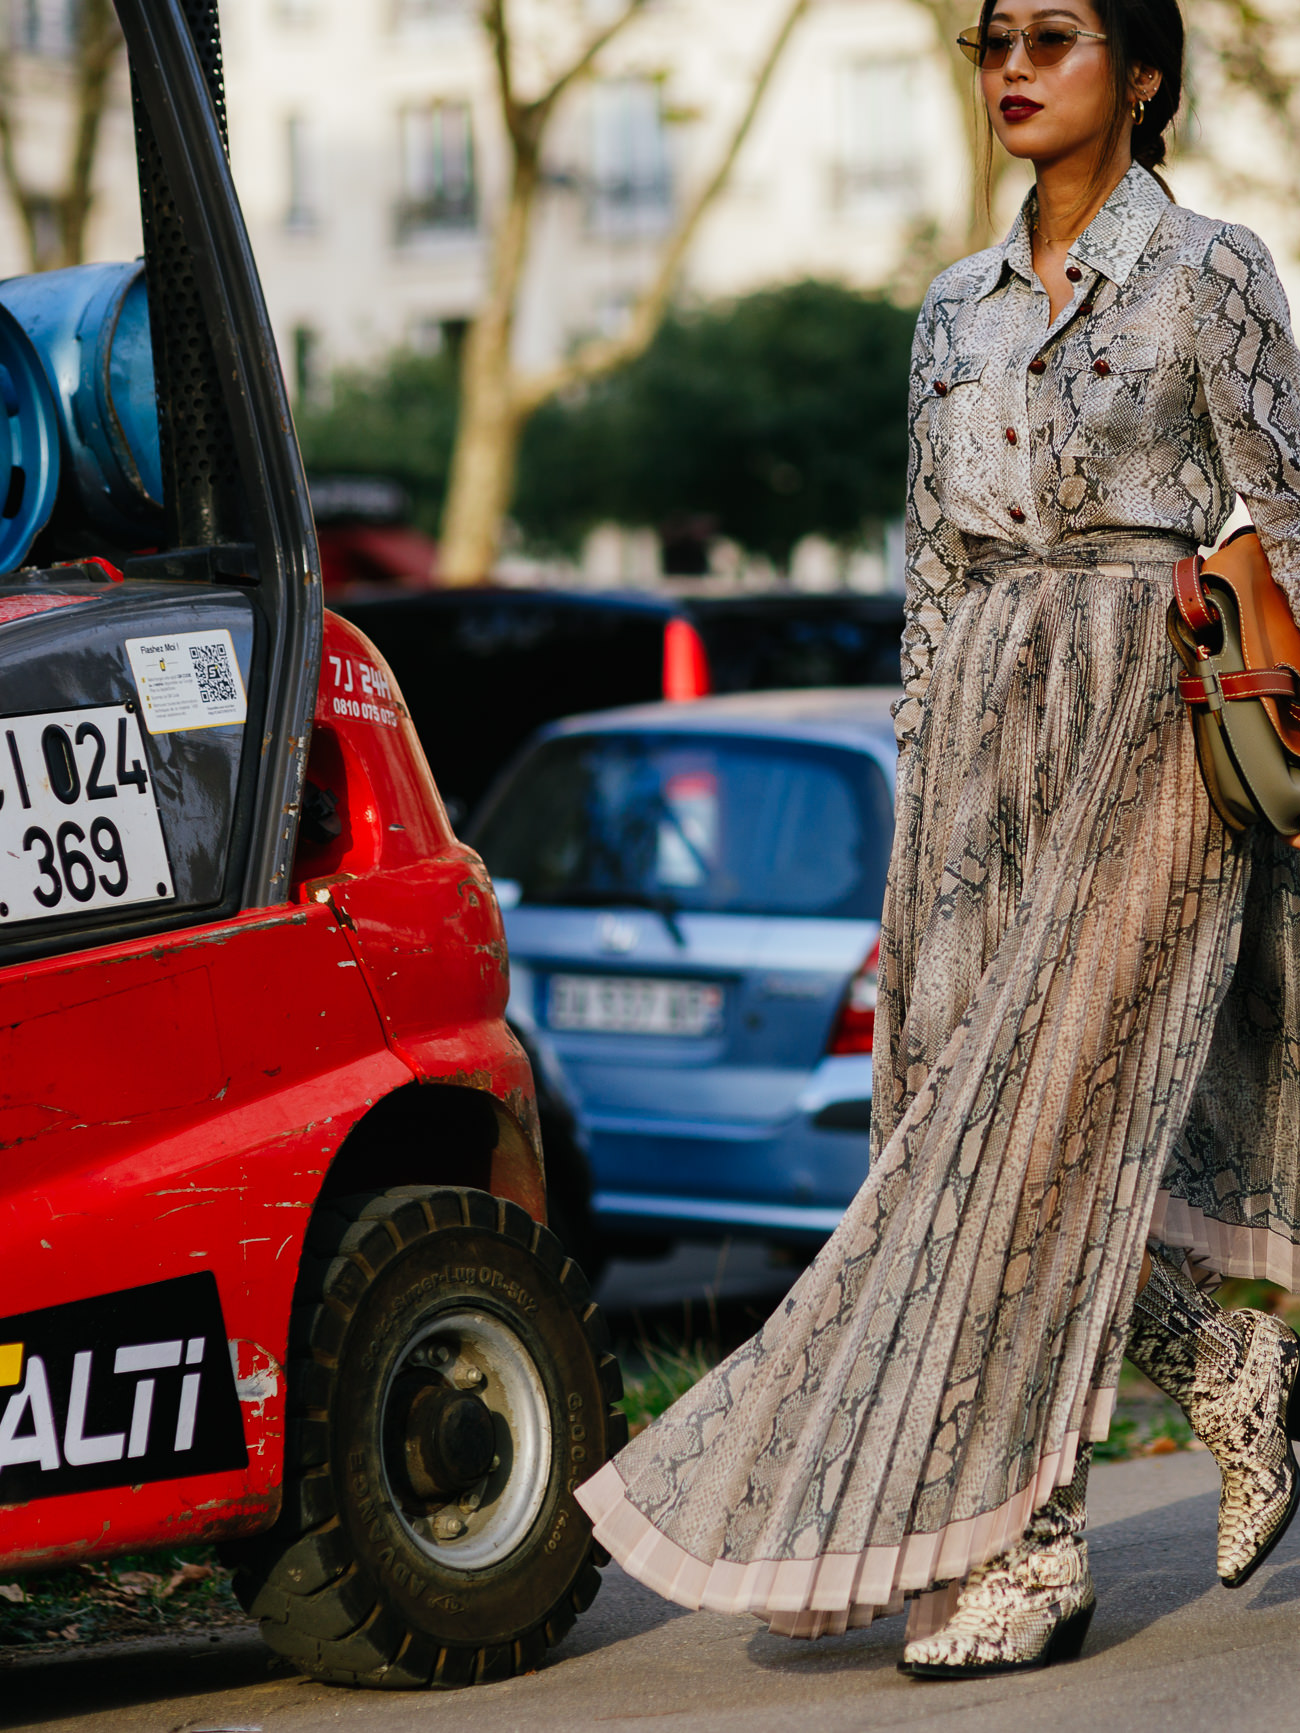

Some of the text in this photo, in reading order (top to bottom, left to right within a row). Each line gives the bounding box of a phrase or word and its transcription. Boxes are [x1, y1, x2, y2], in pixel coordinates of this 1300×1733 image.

[140, 644, 164, 655] Flashez
[164, 642, 176, 652] Moi
[333, 697, 361, 718] 0810
[361, 703, 380, 722] 075
[360, 663, 392, 701] 24H
[41, 717, 149, 804] 024
[23, 816, 128, 908] 369
[348, 1451, 427, 1599] ADVANCE
